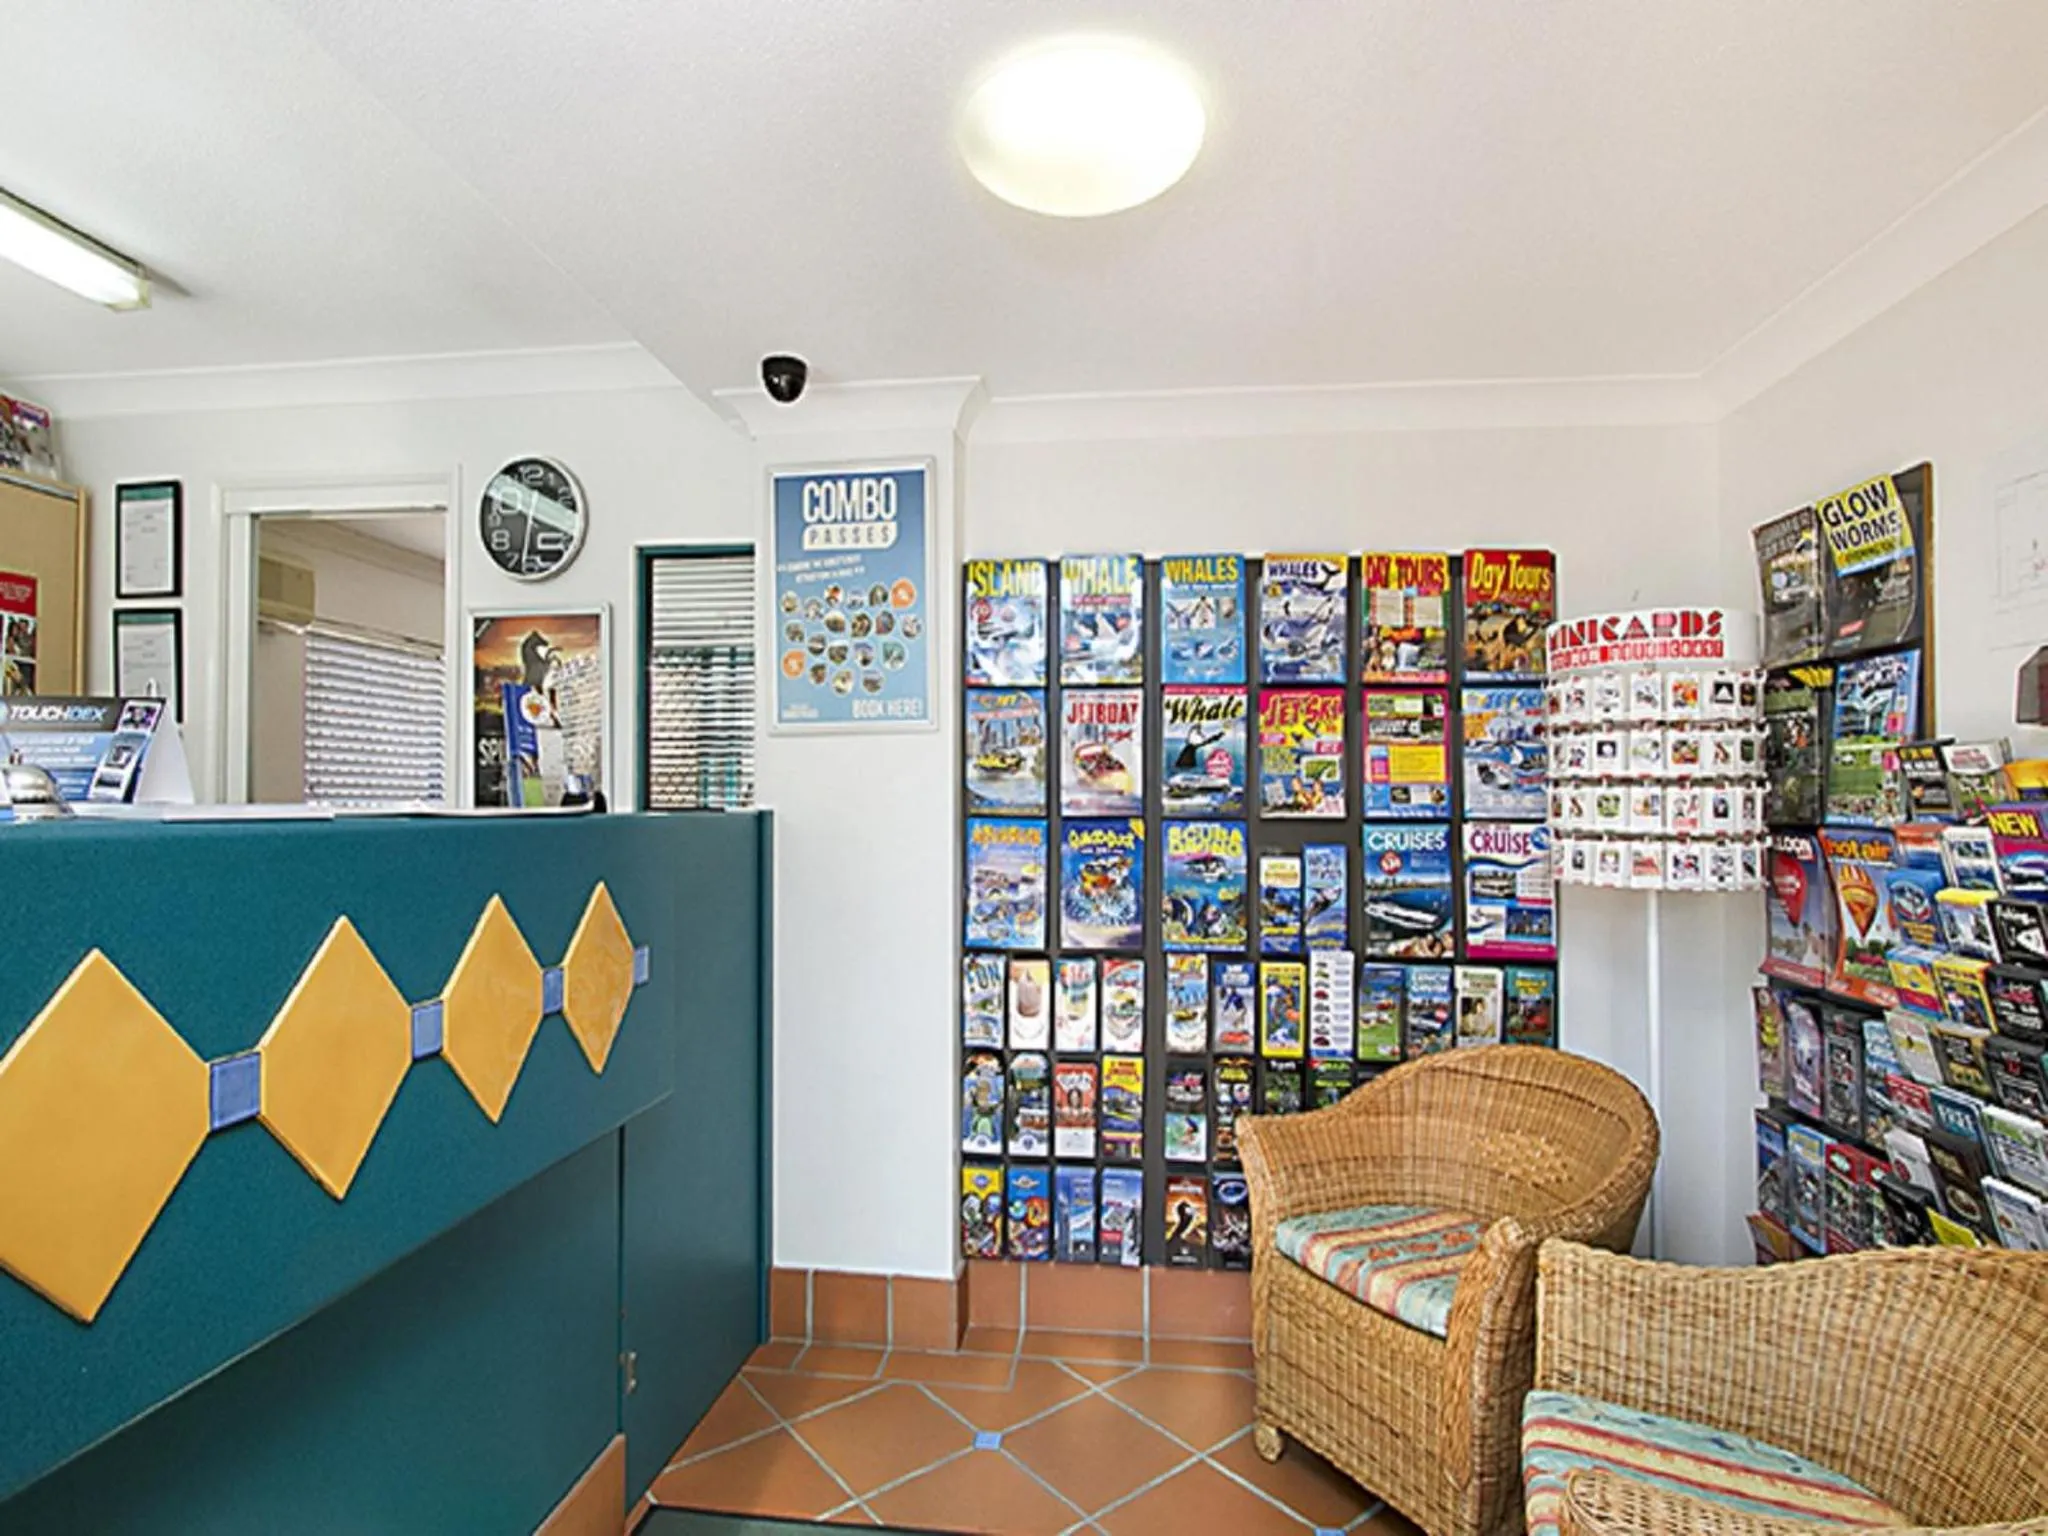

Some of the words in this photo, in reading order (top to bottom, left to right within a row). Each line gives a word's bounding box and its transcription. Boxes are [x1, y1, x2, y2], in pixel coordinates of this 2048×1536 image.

[519, 464, 544, 485] 12
[803, 477, 897, 523] COMBO
[1821, 480, 1889, 528] GLOW
[491, 529, 510, 551] 8
[808, 525, 891, 545] PASSES
[1829, 510, 1904, 551] WORMS
[967, 559, 1042, 597] ISLAND
[1061, 557, 1139, 595] WHALE
[1164, 556, 1239, 585] WHALES
[1267, 561, 1319, 578] WHALES
[1472, 552, 1507, 600] Day
[1507, 553, 1551, 590] Tours
[1067, 702, 1139, 725] JETBOAT
[1164, 695, 1244, 725] Whale
[1987, 811, 2039, 838] NEW
[1368, 831, 1446, 851] CRUISES
[1470, 828, 1533, 855] CRUISE
